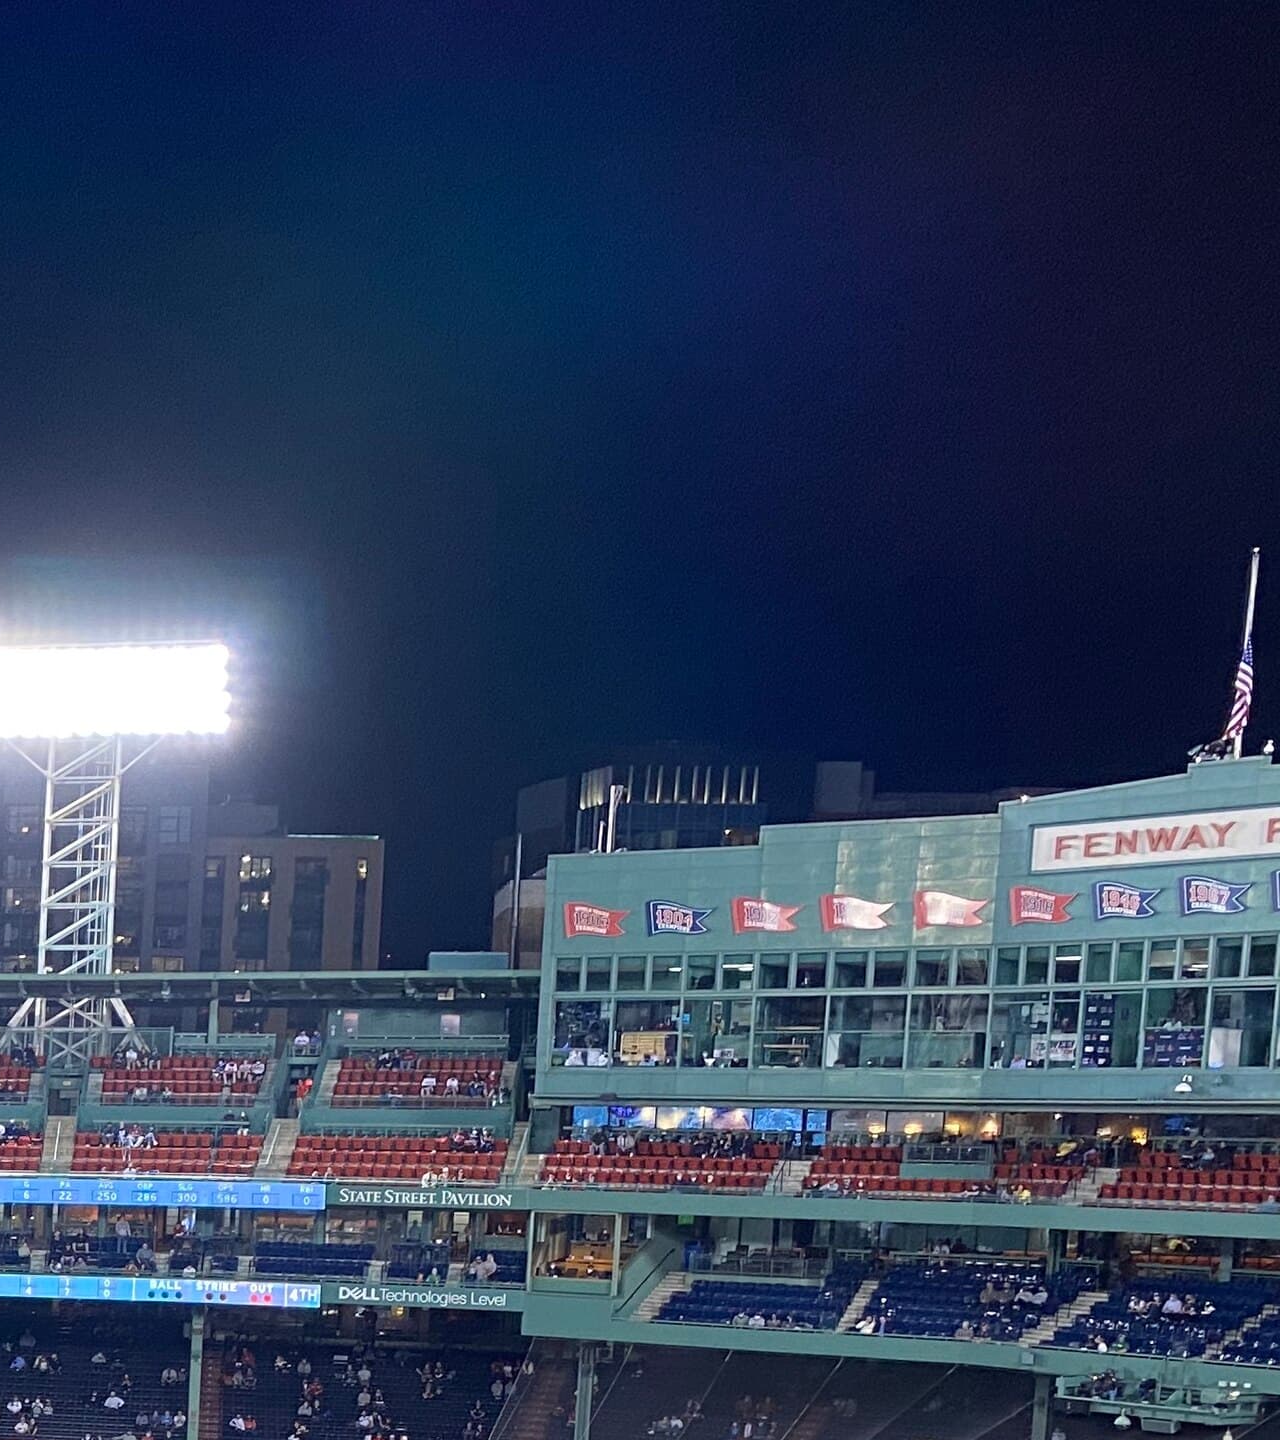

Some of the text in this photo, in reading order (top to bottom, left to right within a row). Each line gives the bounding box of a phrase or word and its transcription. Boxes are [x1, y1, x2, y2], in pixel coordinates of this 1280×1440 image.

[1054, 821, 1236, 860] FENWAY
[1190, 885, 1231, 905] 1967
[23, 1190, 30, 1199] 6
[58, 1191, 72, 1200] 22
[262, 1195, 269, 1204] 0
[339, 1188, 512, 1207] STATE STREET PAVILION
[149, 1279, 317, 1302] BALL STRIKE OUT 4TH
[338, 1287, 506, 1307] DELL Technologies Level
